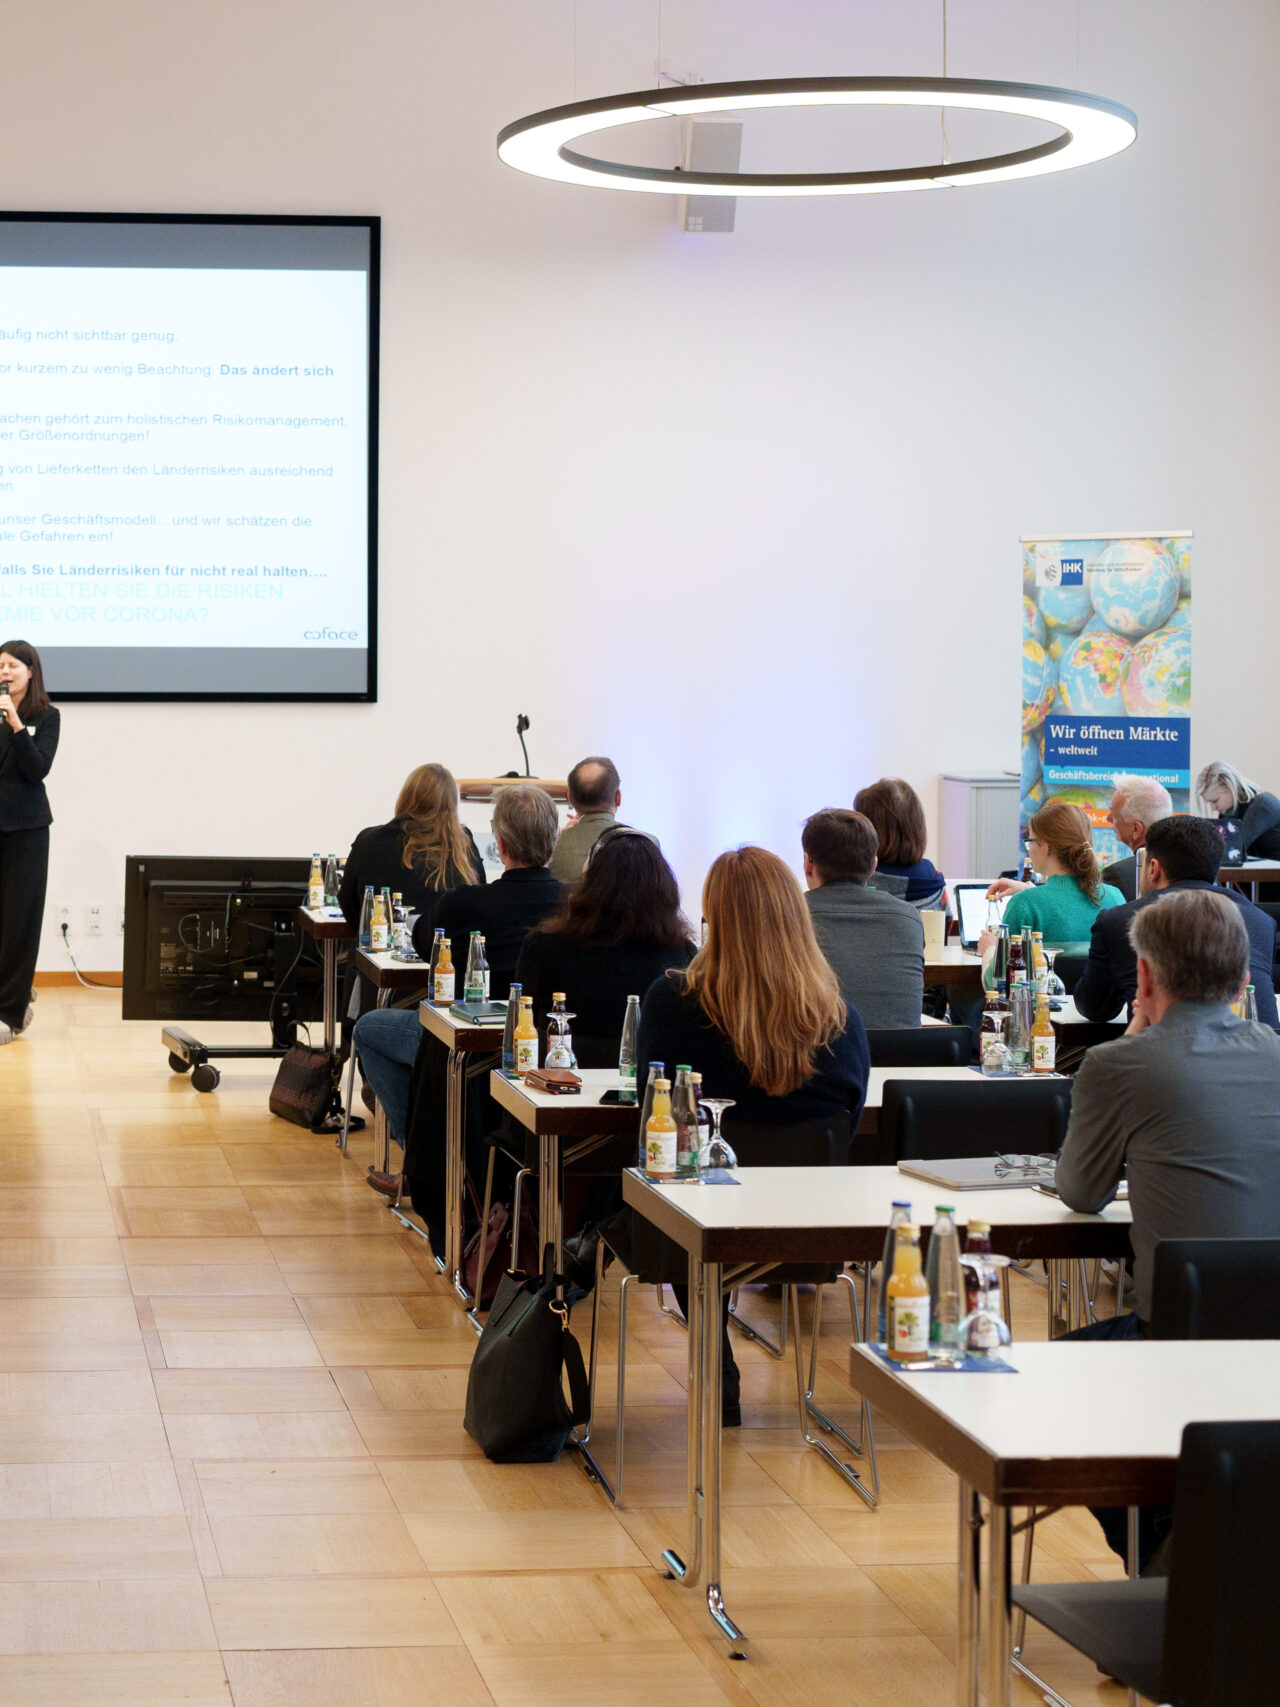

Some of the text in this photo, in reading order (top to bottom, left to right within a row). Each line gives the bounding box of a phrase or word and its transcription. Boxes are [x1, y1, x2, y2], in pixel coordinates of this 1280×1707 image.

[36, 328, 68, 340] nicht
[73, 329, 127, 341] sichtbar
[17, 362, 67, 374] kurzem
[72, 365, 88, 374] zu
[93, 364, 132, 377] wenig
[220, 364, 247, 375] Das
[252, 365, 299, 376] ändert
[304, 365, 333, 376] sich
[45, 413, 89, 426] gehört
[94, 416, 122, 424] zum
[127, 414, 207, 425] holistischen
[8, 464, 32, 474] von
[38, 464, 118, 474] Lieferketten
[122, 464, 148, 475] den
[153, 464, 245, 476] Länderrisiken
[249, 465, 333, 476] ausreichend
[202, 517, 221, 526] wir
[226, 515, 288, 527] schätzen
[292, 516, 312, 527] die
[20, 530, 84, 542] Gefahren
[88, 531, 112, 542] ein!
[32, 564, 54, 575] Sie
[60, 565, 160, 576] Länderrisiken
[165, 565, 185, 576] für
[190, 566, 226, 576] nicht
[232, 566, 258, 576] real
[1063, 562, 1082, 573] IHK
[19, 582, 107, 599] HIELTEN
[115, 582, 148, 599] SIE
[156, 583, 190, 599] DIE
[198, 583, 282, 599] RISIKEN
[51, 606, 96, 622] VOR
[1050, 725, 1179, 741] Wir öffnen Märkte
[1058, 745, 1098, 755] weltweit
[1049, 769, 1119, 782] Geschäftsbereic
